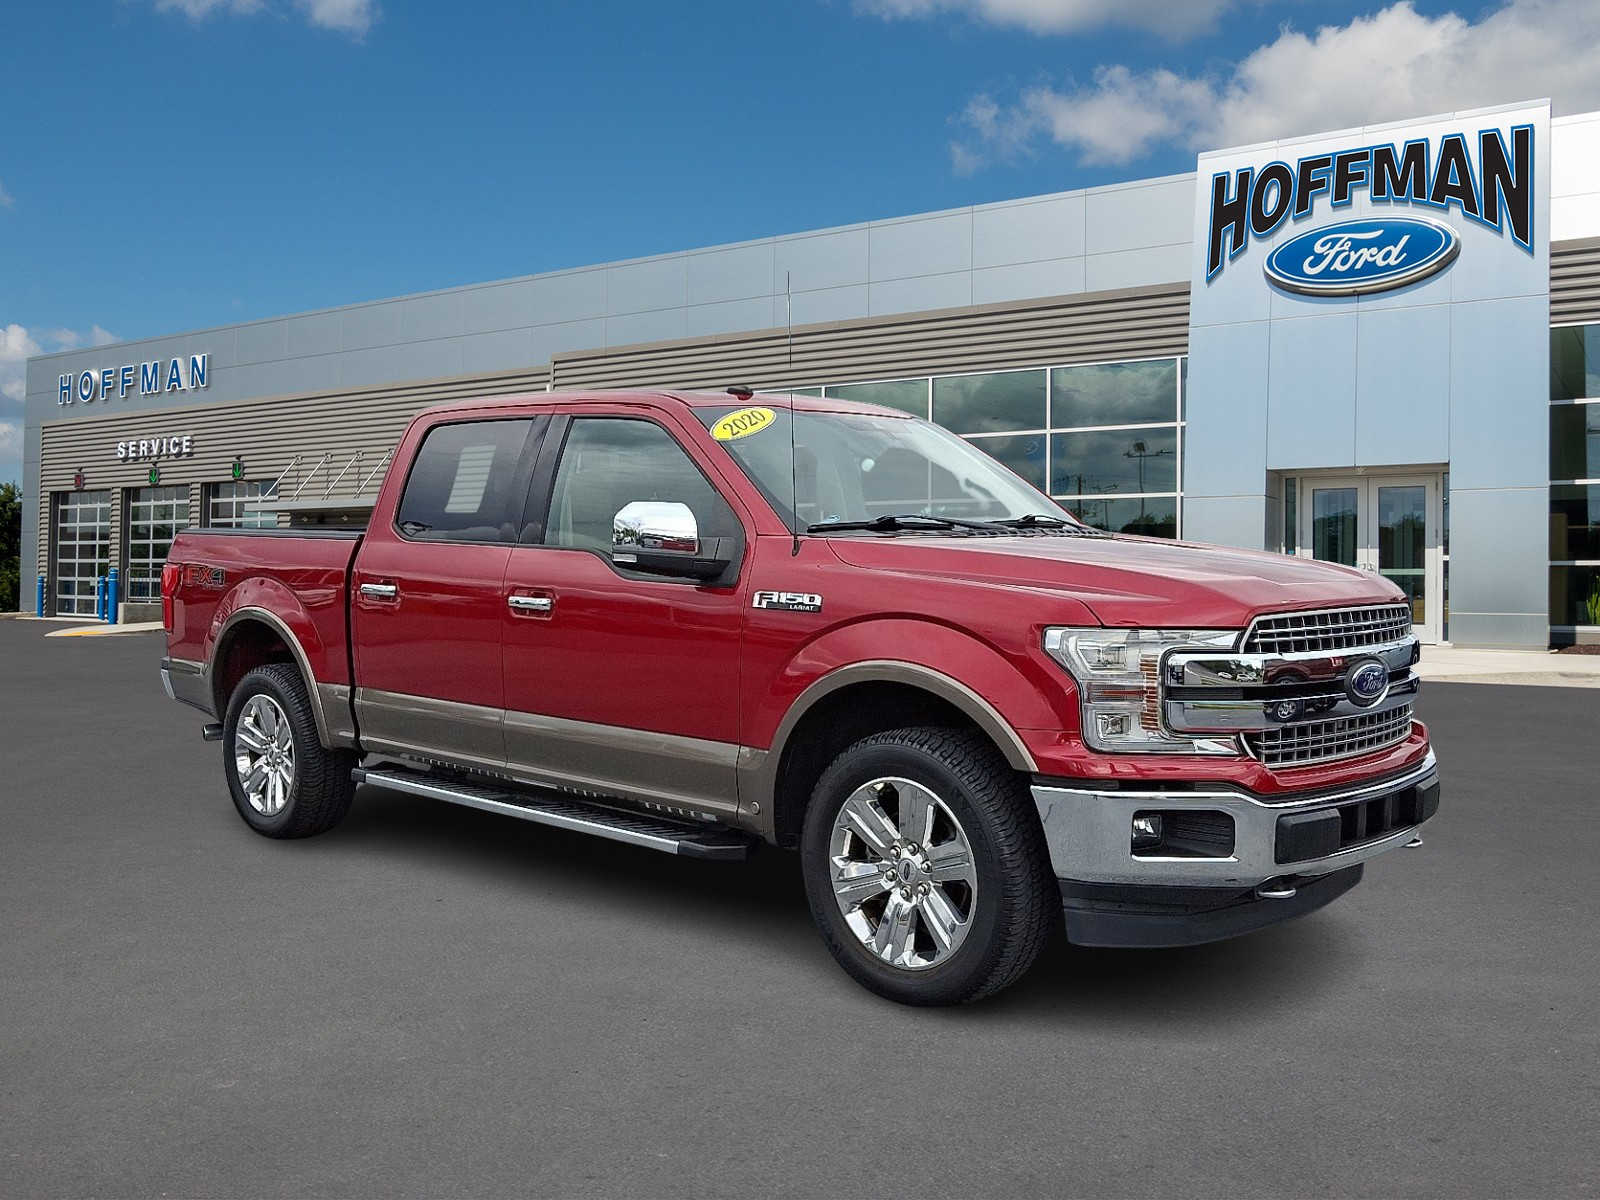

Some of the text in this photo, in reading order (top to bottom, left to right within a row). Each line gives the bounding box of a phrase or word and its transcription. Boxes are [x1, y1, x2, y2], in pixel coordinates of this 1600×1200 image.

[1206, 124, 1534, 283] HOFFMAN
[1303, 229, 1410, 275] Ford
[58, 354, 208, 405] HOFFMAN
[722, 410, 766, 436] 2020
[117, 436, 192, 459] SERVICE
[187, 567, 225, 587] FX4
[1361, 670, 1385, 691] Ford
